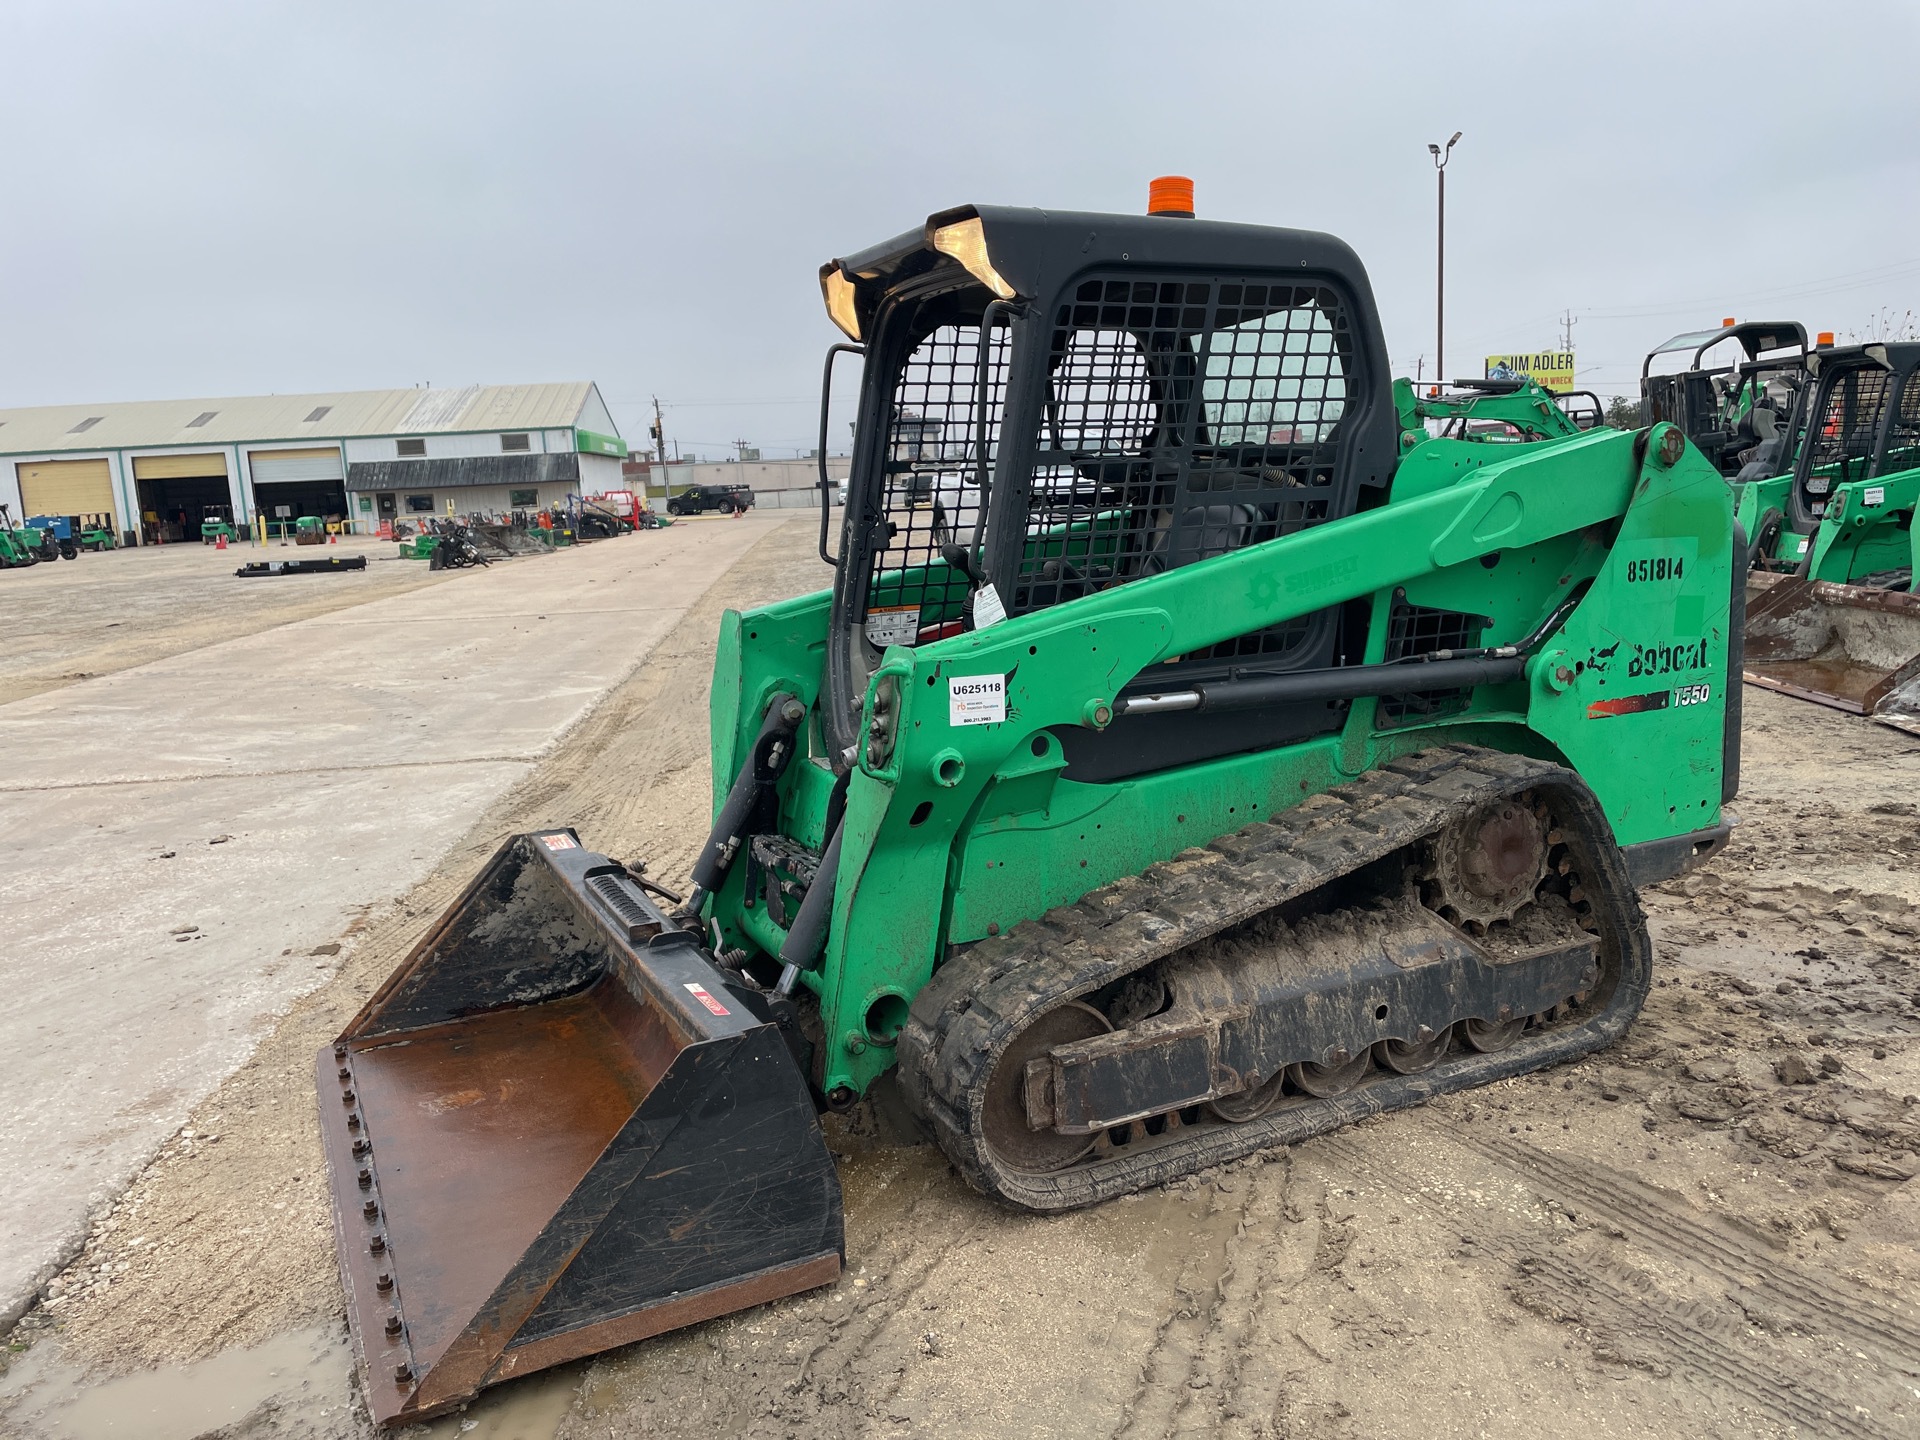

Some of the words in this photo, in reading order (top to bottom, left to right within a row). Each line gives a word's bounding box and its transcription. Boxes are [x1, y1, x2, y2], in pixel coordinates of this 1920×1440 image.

[1510, 355, 1529, 371] JIM
[1533, 354, 1573, 371] ADLER
[1550, 376, 1573, 385] WRECK
[1627, 557, 1683, 583] 851814
[1628, 637, 1708, 678] Bobcat
[953, 682, 1001, 695] U625118
[1674, 683, 1711, 708] T550
